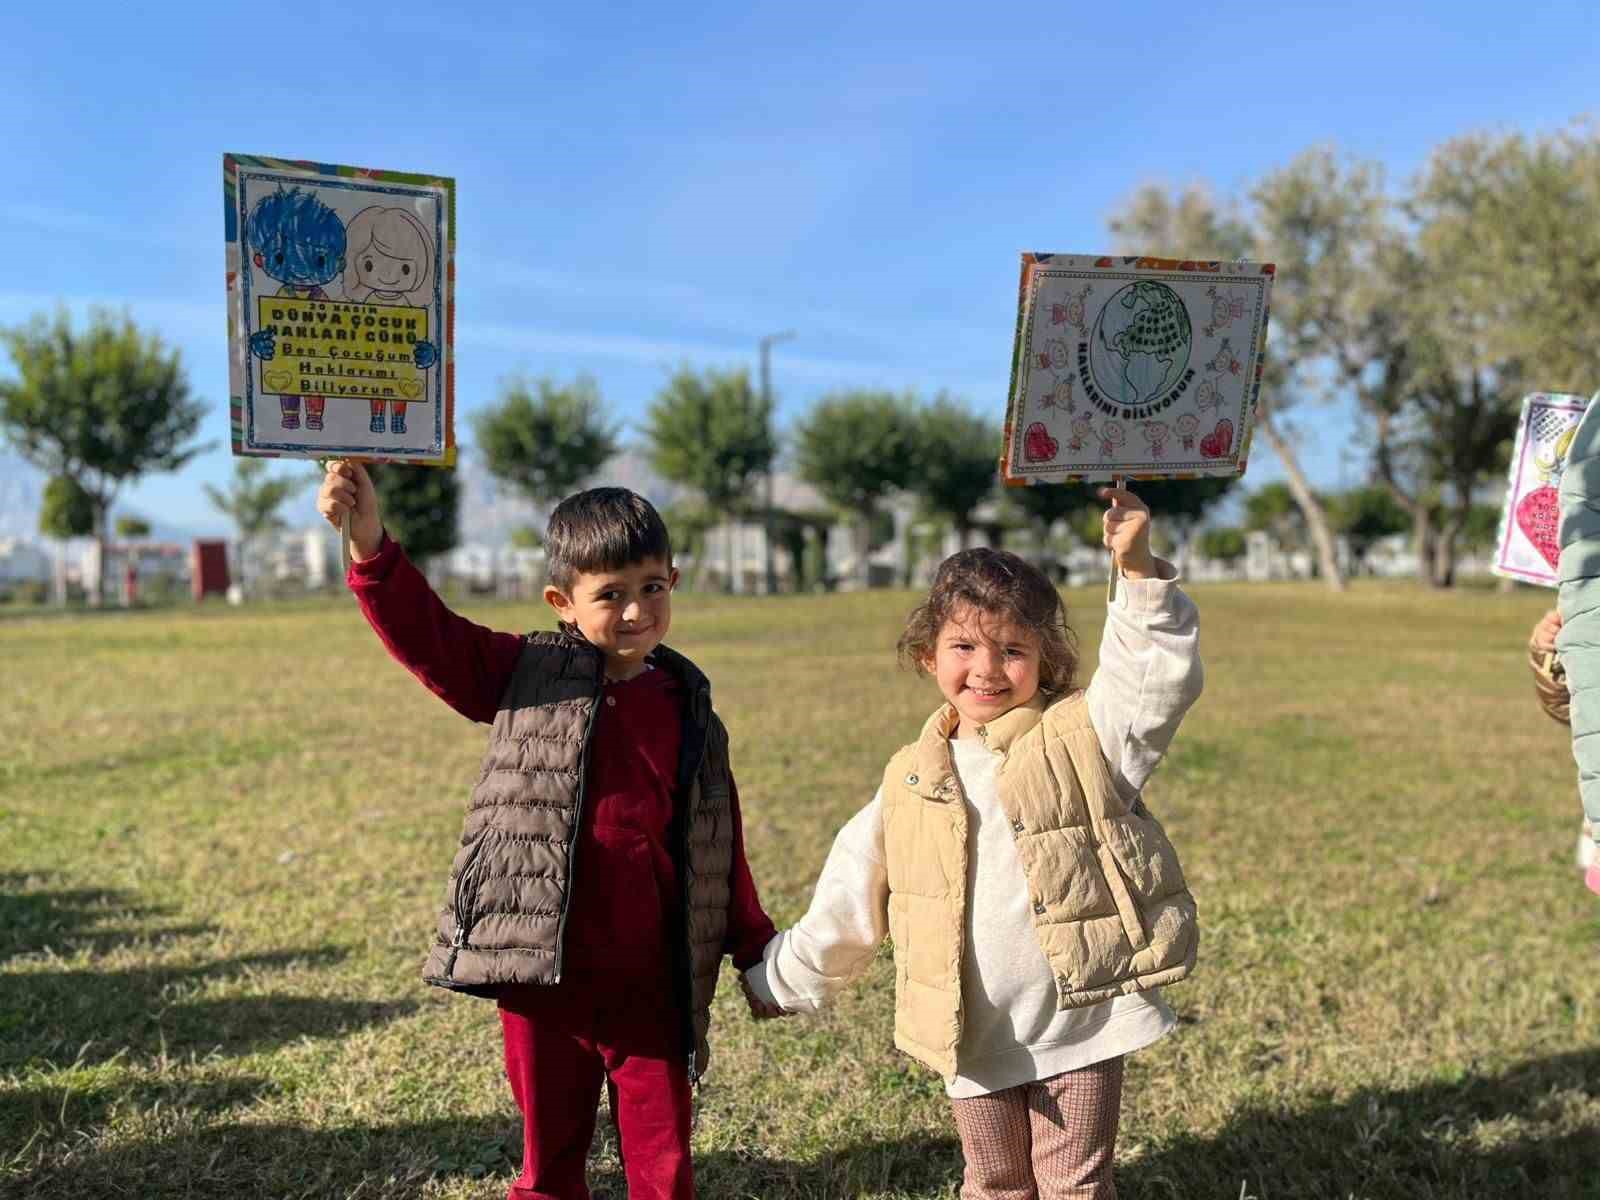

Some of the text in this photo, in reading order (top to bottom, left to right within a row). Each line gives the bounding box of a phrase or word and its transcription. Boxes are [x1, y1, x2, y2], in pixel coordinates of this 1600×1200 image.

[271, 308, 417, 329] DÜNYA ÇOCUK
[267, 324, 356, 341] HAKLARI
[282, 343, 317, 357] Ben
[299, 361, 395, 377] Haklarımı
[300, 379, 394, 395] Biliyorum
